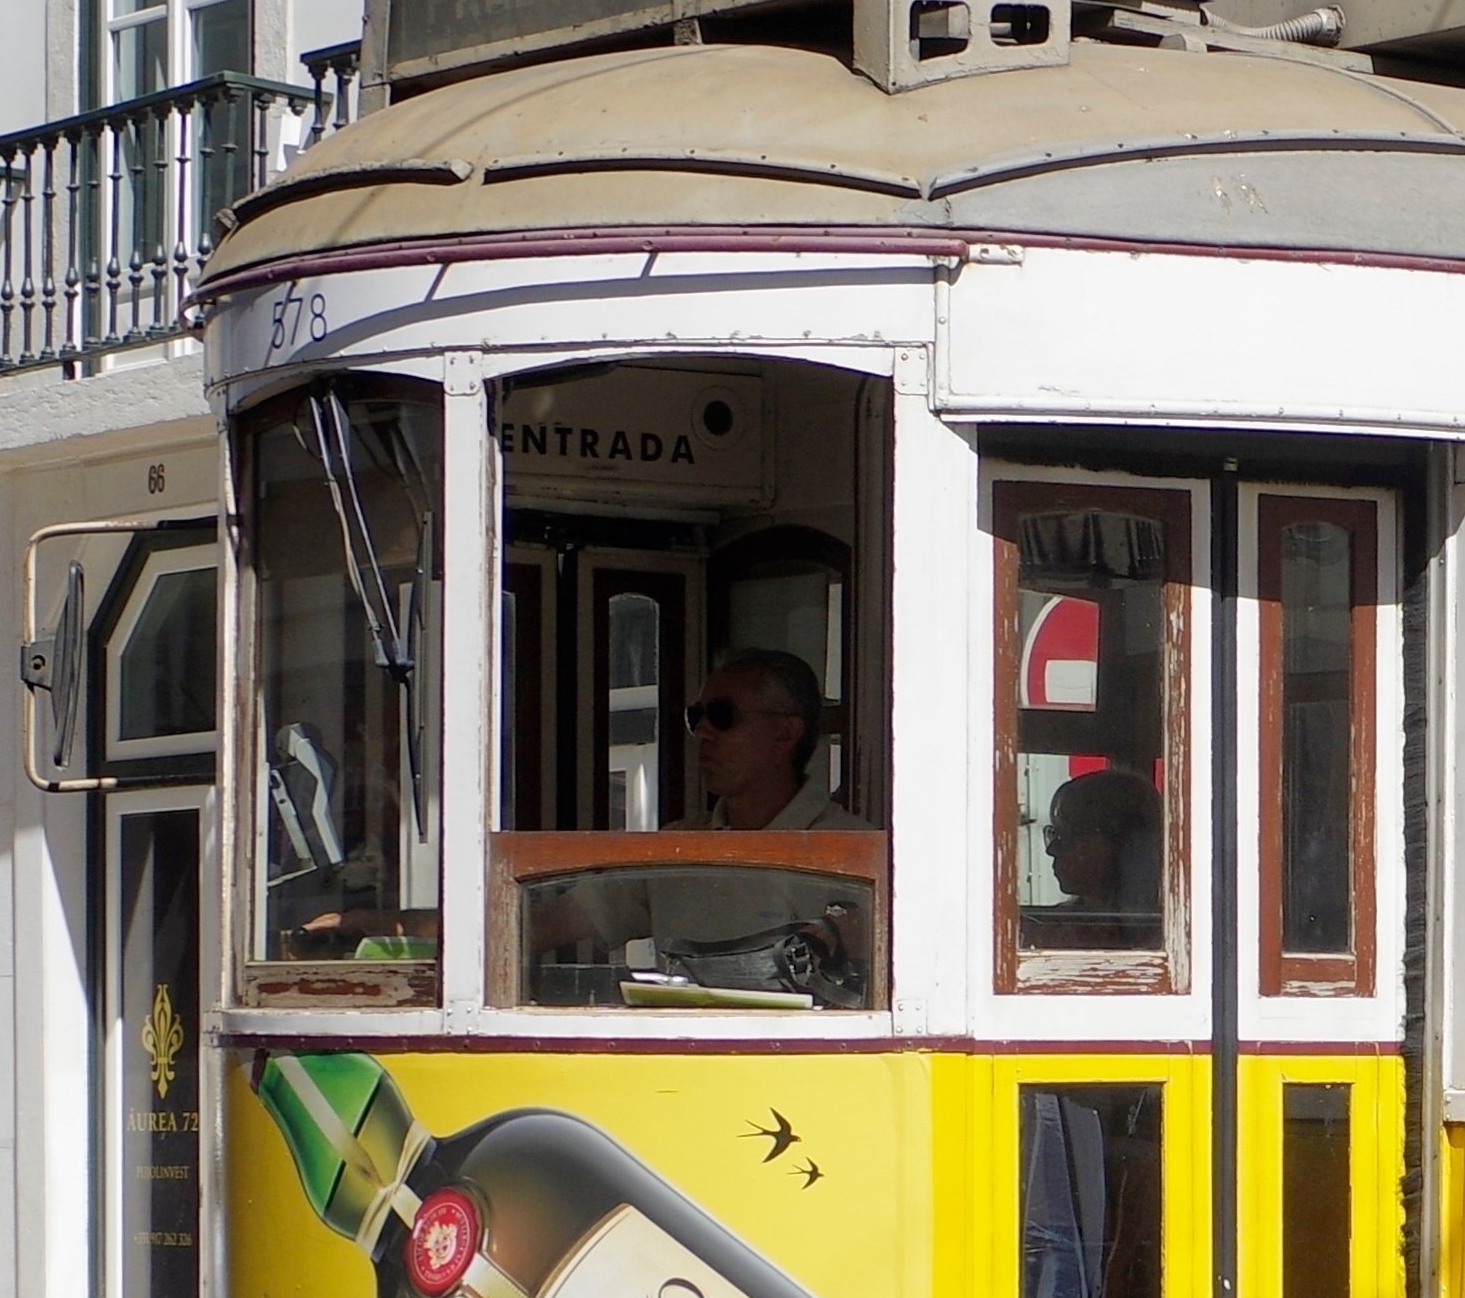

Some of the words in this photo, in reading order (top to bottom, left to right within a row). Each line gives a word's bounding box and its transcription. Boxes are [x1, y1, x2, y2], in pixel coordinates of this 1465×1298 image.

[271, 292, 329, 349] 578
[501, 420, 696, 467] ENTRADA
[147, 463, 166, 496] 66
[127, 1107, 177, 1132] ÁUREA
[182, 1112, 199, 1131] 72
